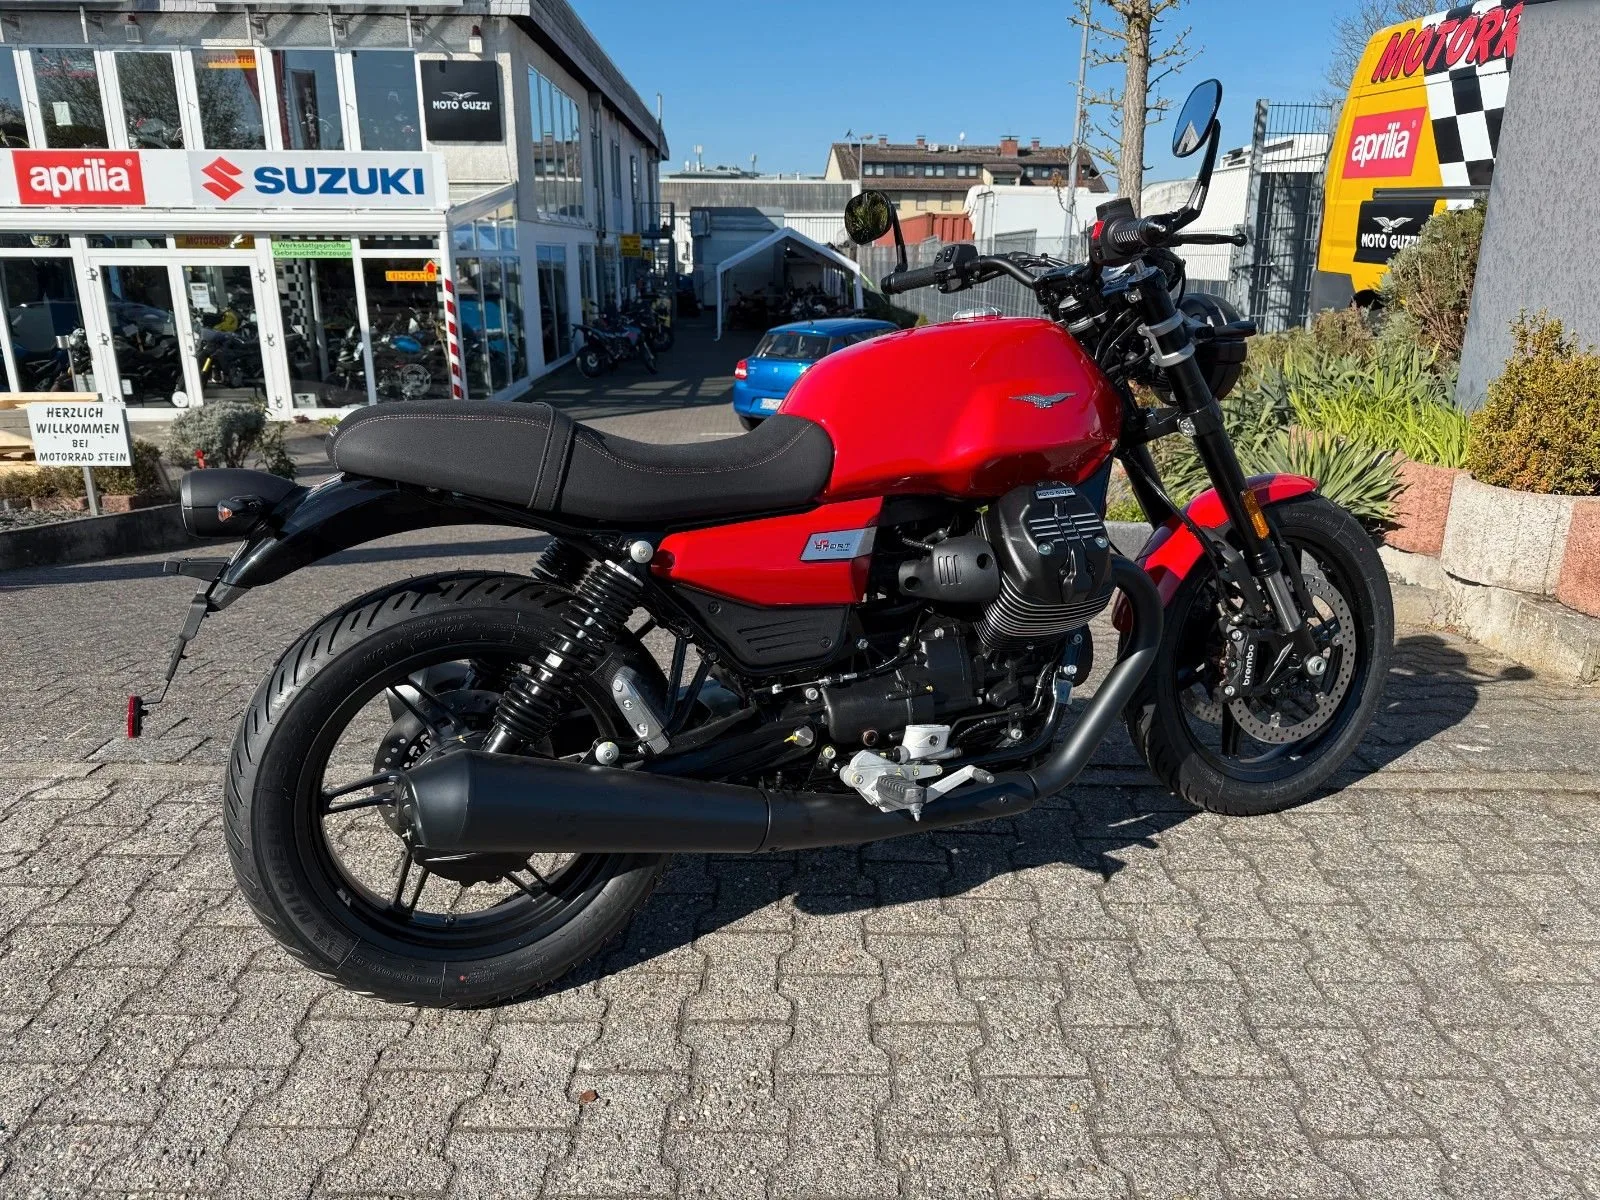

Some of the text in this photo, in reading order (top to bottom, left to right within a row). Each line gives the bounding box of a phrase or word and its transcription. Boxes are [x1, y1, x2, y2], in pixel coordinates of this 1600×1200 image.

[432, 101, 491, 111] MOTO GUZZI
[1351, 121, 1411, 168] aprilia
[29, 158, 131, 198] aprilia
[253, 166, 425, 195] SUZUKI
[1361, 233, 1387, 249] MOTO
[388, 271, 436, 281] EINGANG
[46, 407, 104, 418] HERZLICH
[36, 423, 120, 435] WILLKOMMEN
[72, 439, 89, 448] BEI
[40, 452, 127, 462] MOTORRAD STEIN
[1242, 644, 1255, 686] brembo
